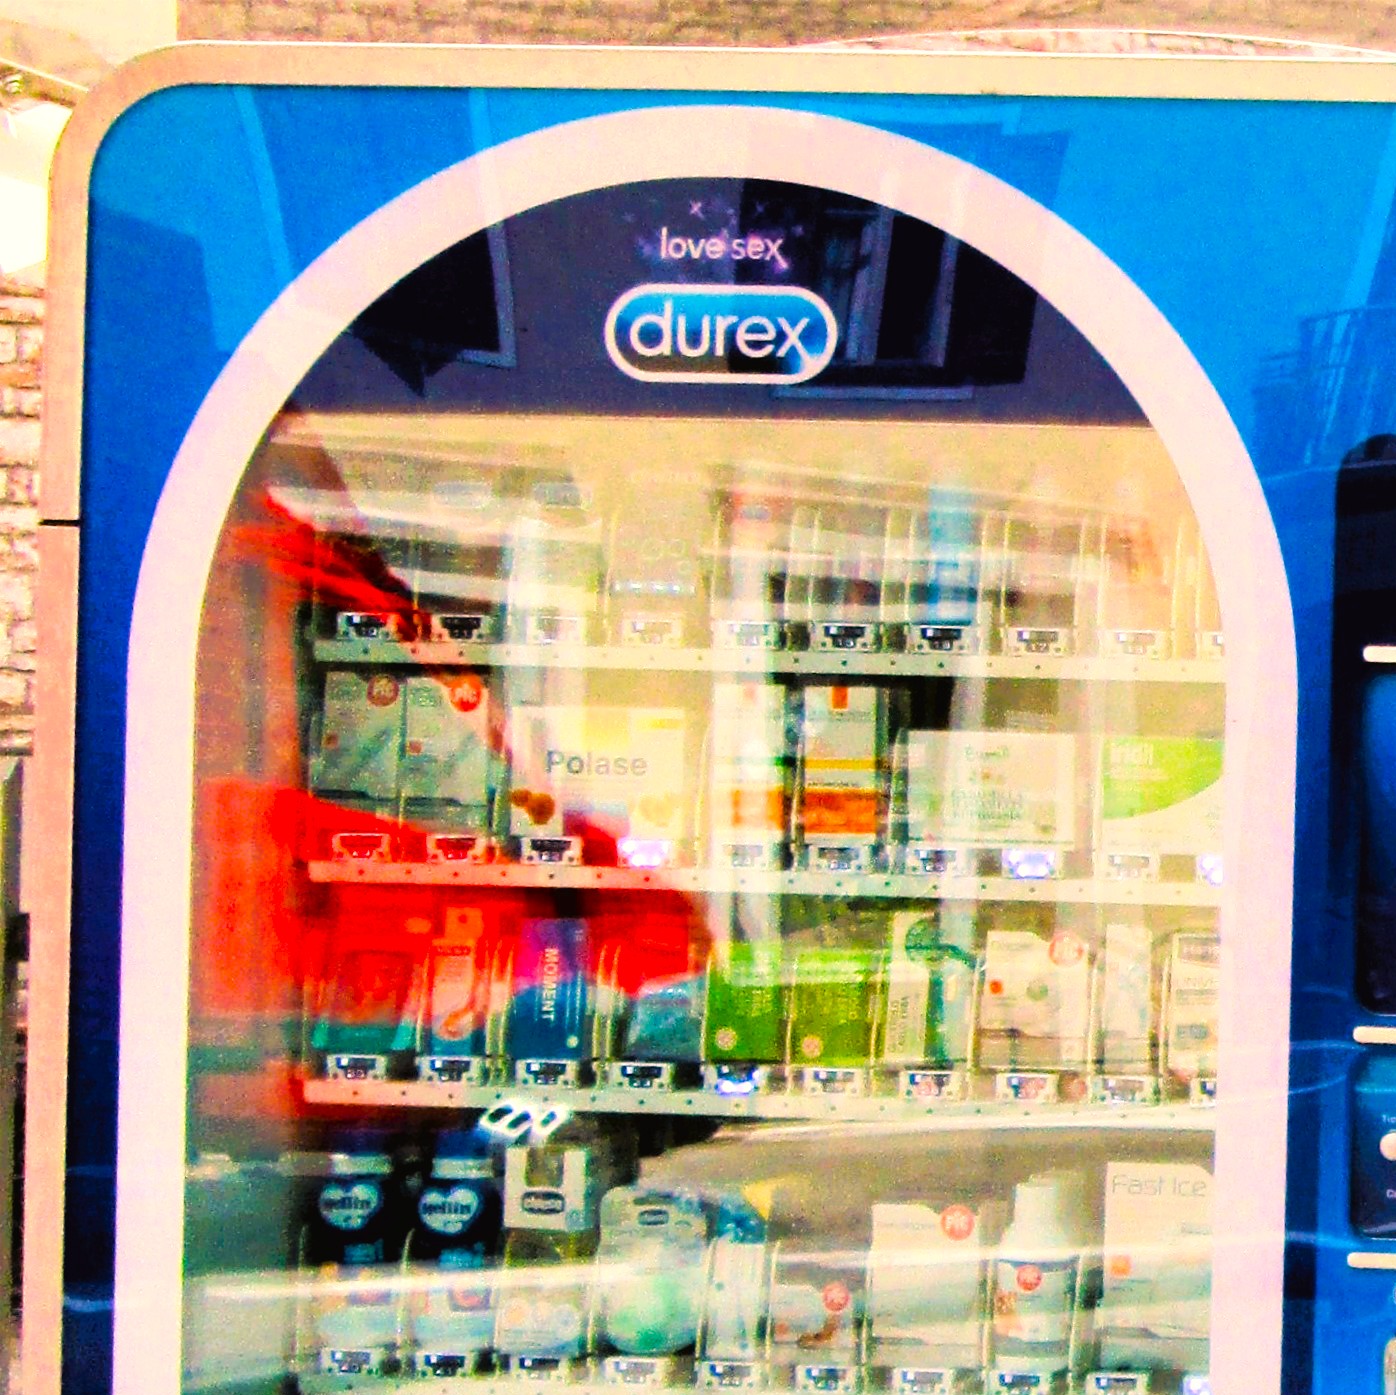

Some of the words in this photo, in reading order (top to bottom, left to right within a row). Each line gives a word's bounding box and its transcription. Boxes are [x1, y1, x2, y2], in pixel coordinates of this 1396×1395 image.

[660, 226, 726, 260] love
[731, 236, 789, 270] sex
[629, 299, 814, 362] durex
[545, 750, 648, 776] Polase
[541, 947, 559, 1021] MOMENT
[1112, 1174, 1164, 1196] Fast
[1173, 1177, 1207, 1198] Ice
